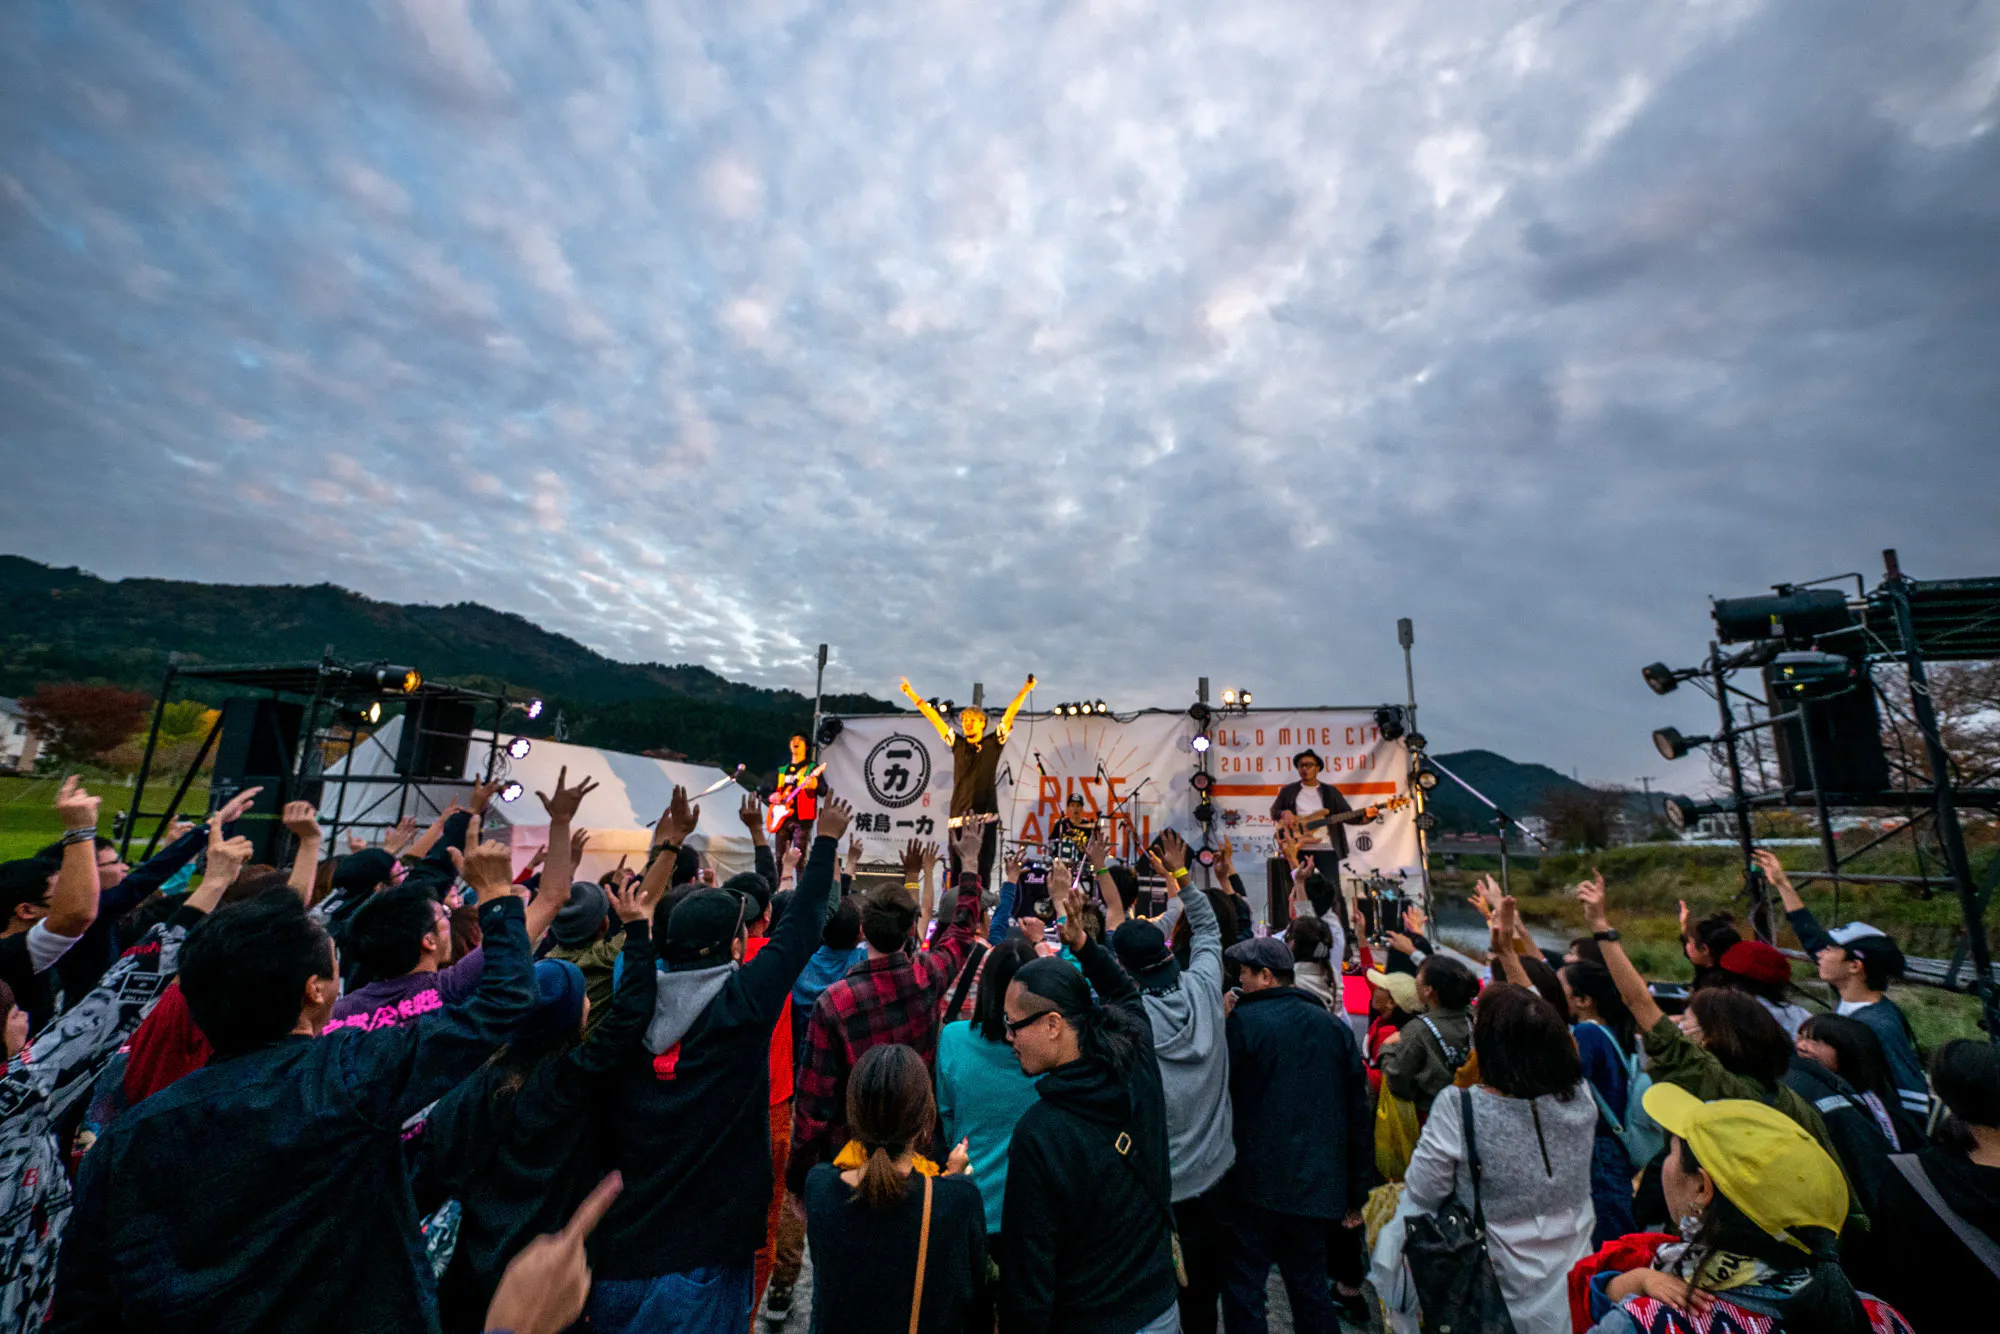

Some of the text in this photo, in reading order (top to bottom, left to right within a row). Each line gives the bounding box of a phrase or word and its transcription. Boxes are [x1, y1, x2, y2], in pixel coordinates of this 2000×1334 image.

[1278, 728, 1331, 745] MINE
[1345, 726, 1380, 745] CIT
[1038, 776, 1129, 820] RISE
[855, 812, 891, 833] 焼鳥
